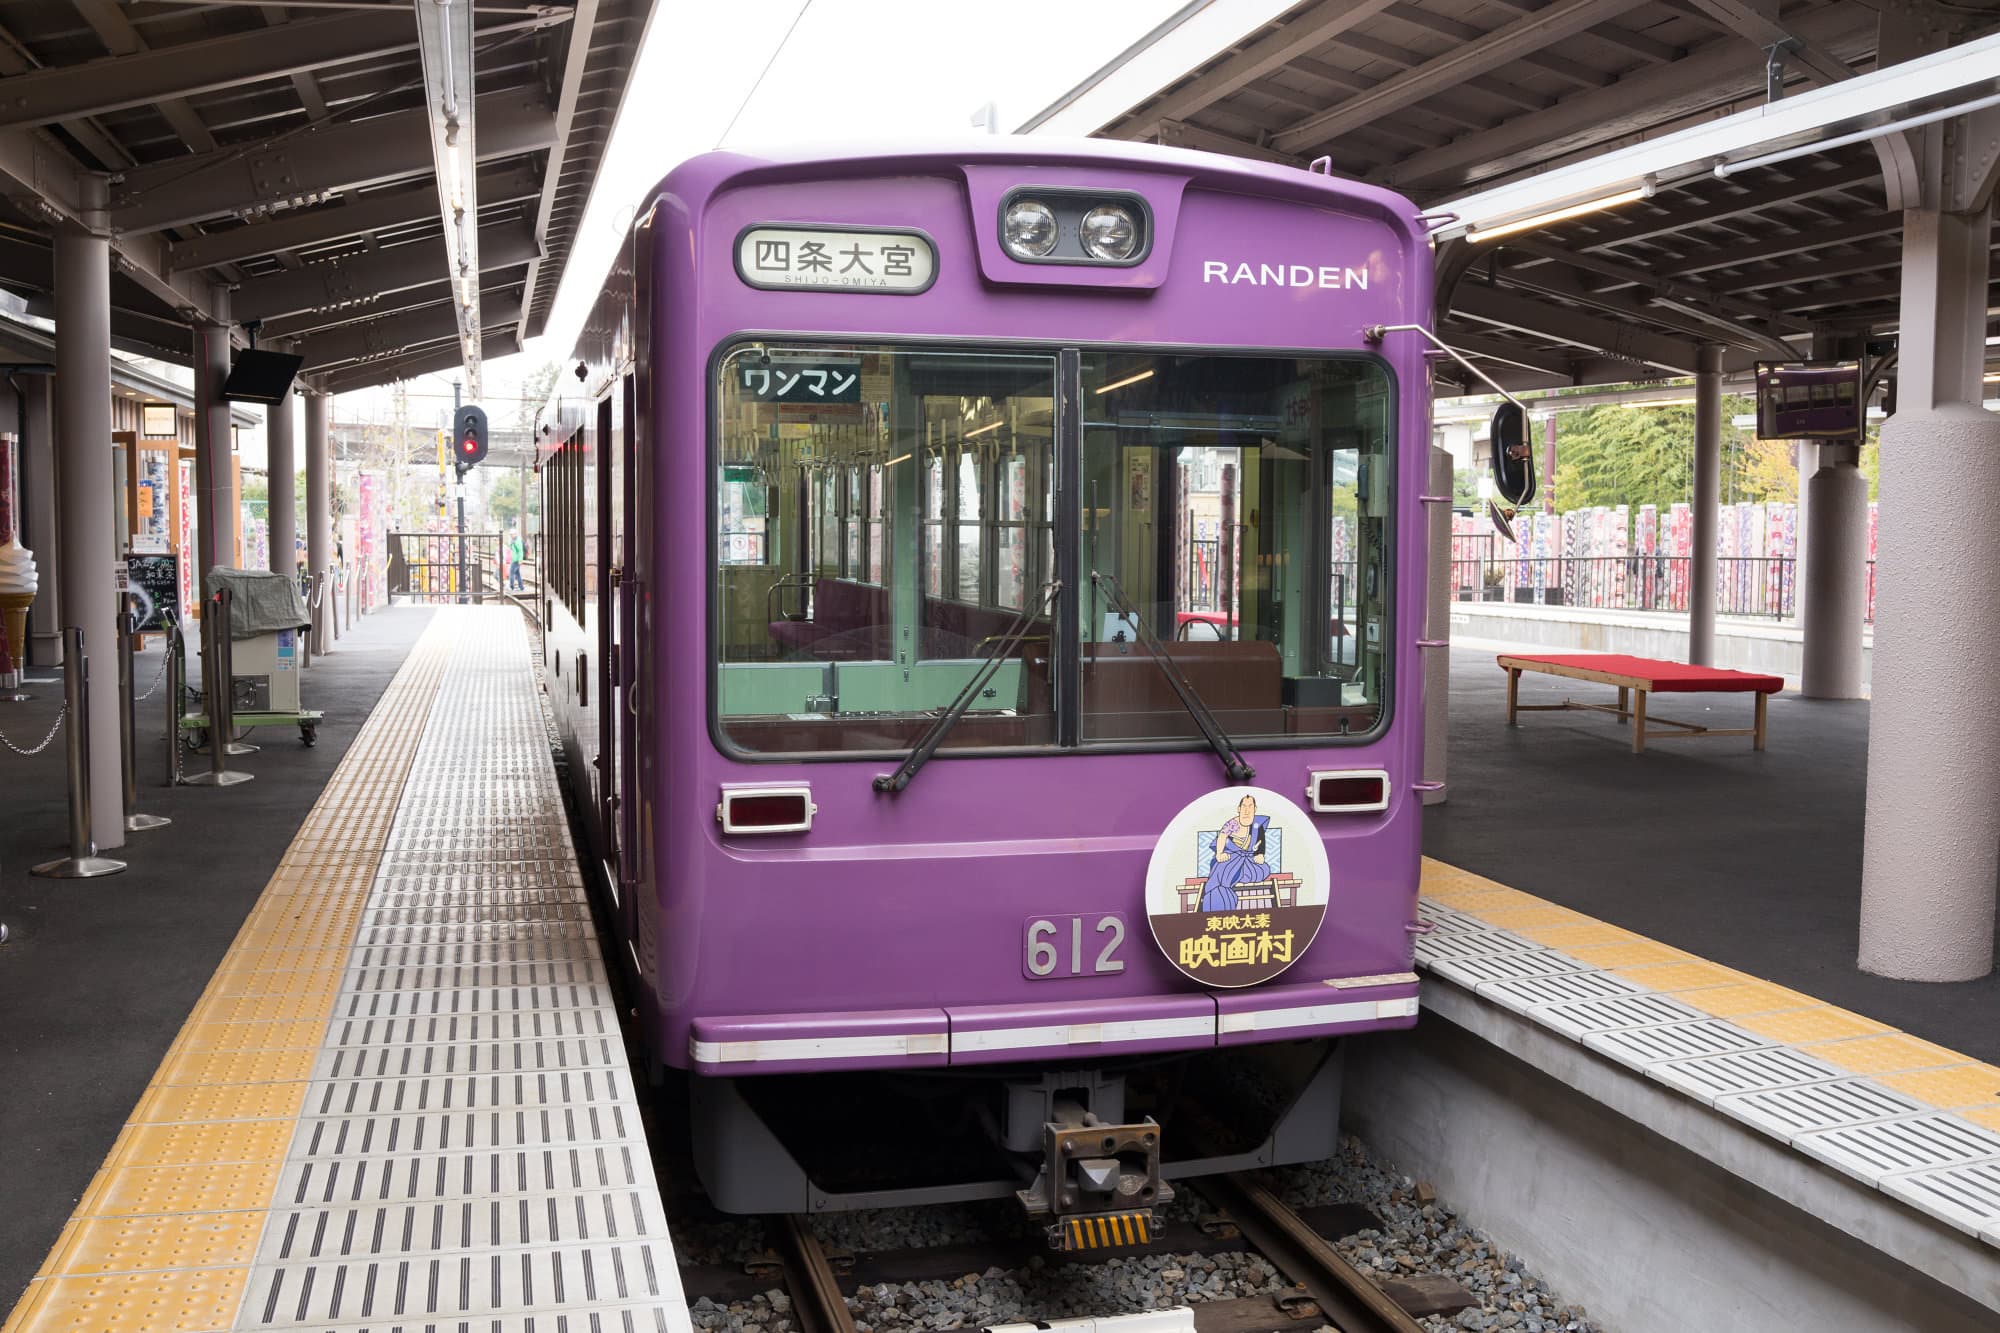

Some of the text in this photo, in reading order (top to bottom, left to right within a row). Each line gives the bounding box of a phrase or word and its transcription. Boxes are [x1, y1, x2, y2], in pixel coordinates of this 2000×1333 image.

[755, 240, 915, 276] 四条大宮
[784, 274, 887, 287] SHIJO-OMIYA
[1203, 260, 1369, 291] RANDEN
[744, 369, 857, 396] ワンマン
[1204, 913, 1272, 932] 東映太秦
[1027, 916, 1125, 976] 612
[1179, 929, 1295, 969] 映画村
